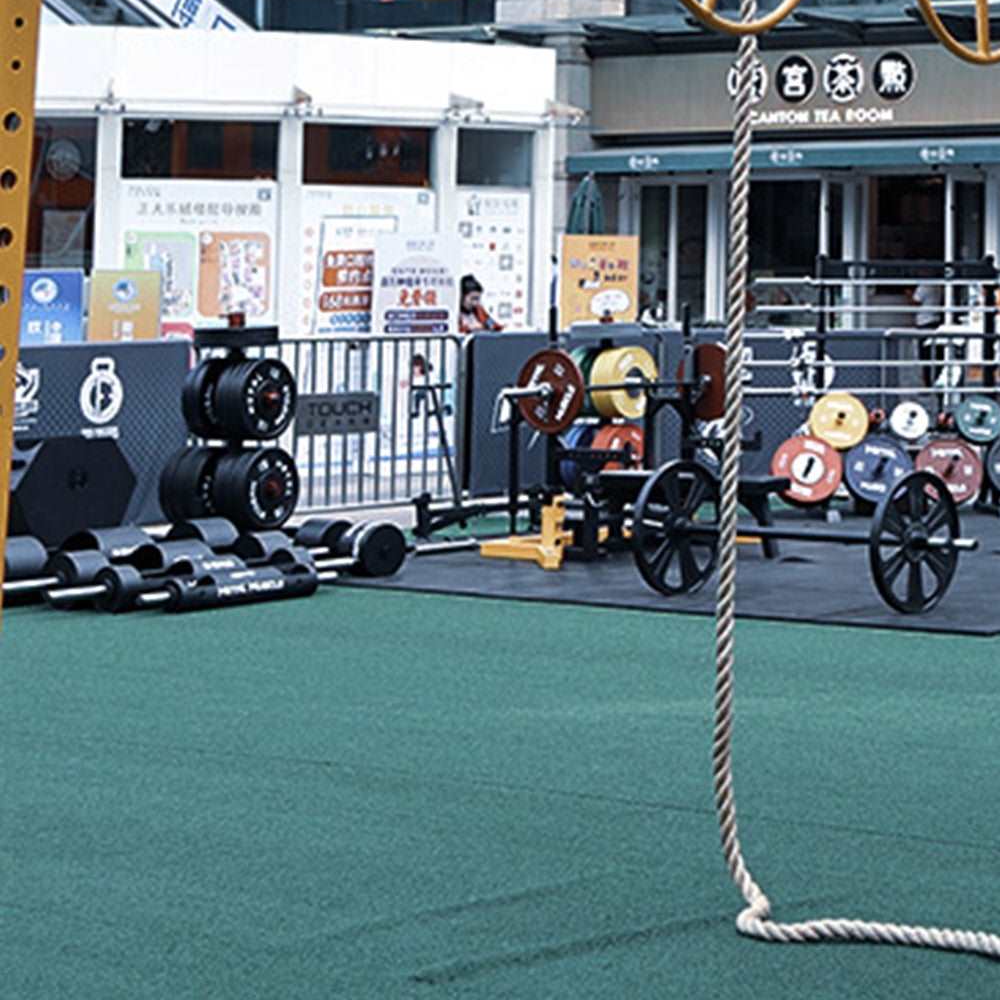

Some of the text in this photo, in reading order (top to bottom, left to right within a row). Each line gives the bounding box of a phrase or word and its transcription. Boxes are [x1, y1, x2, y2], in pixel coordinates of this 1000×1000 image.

[814, 108, 841, 124] TEA
[845, 107, 894, 123] ROOM
[308, 400, 373, 418] TOUCH
